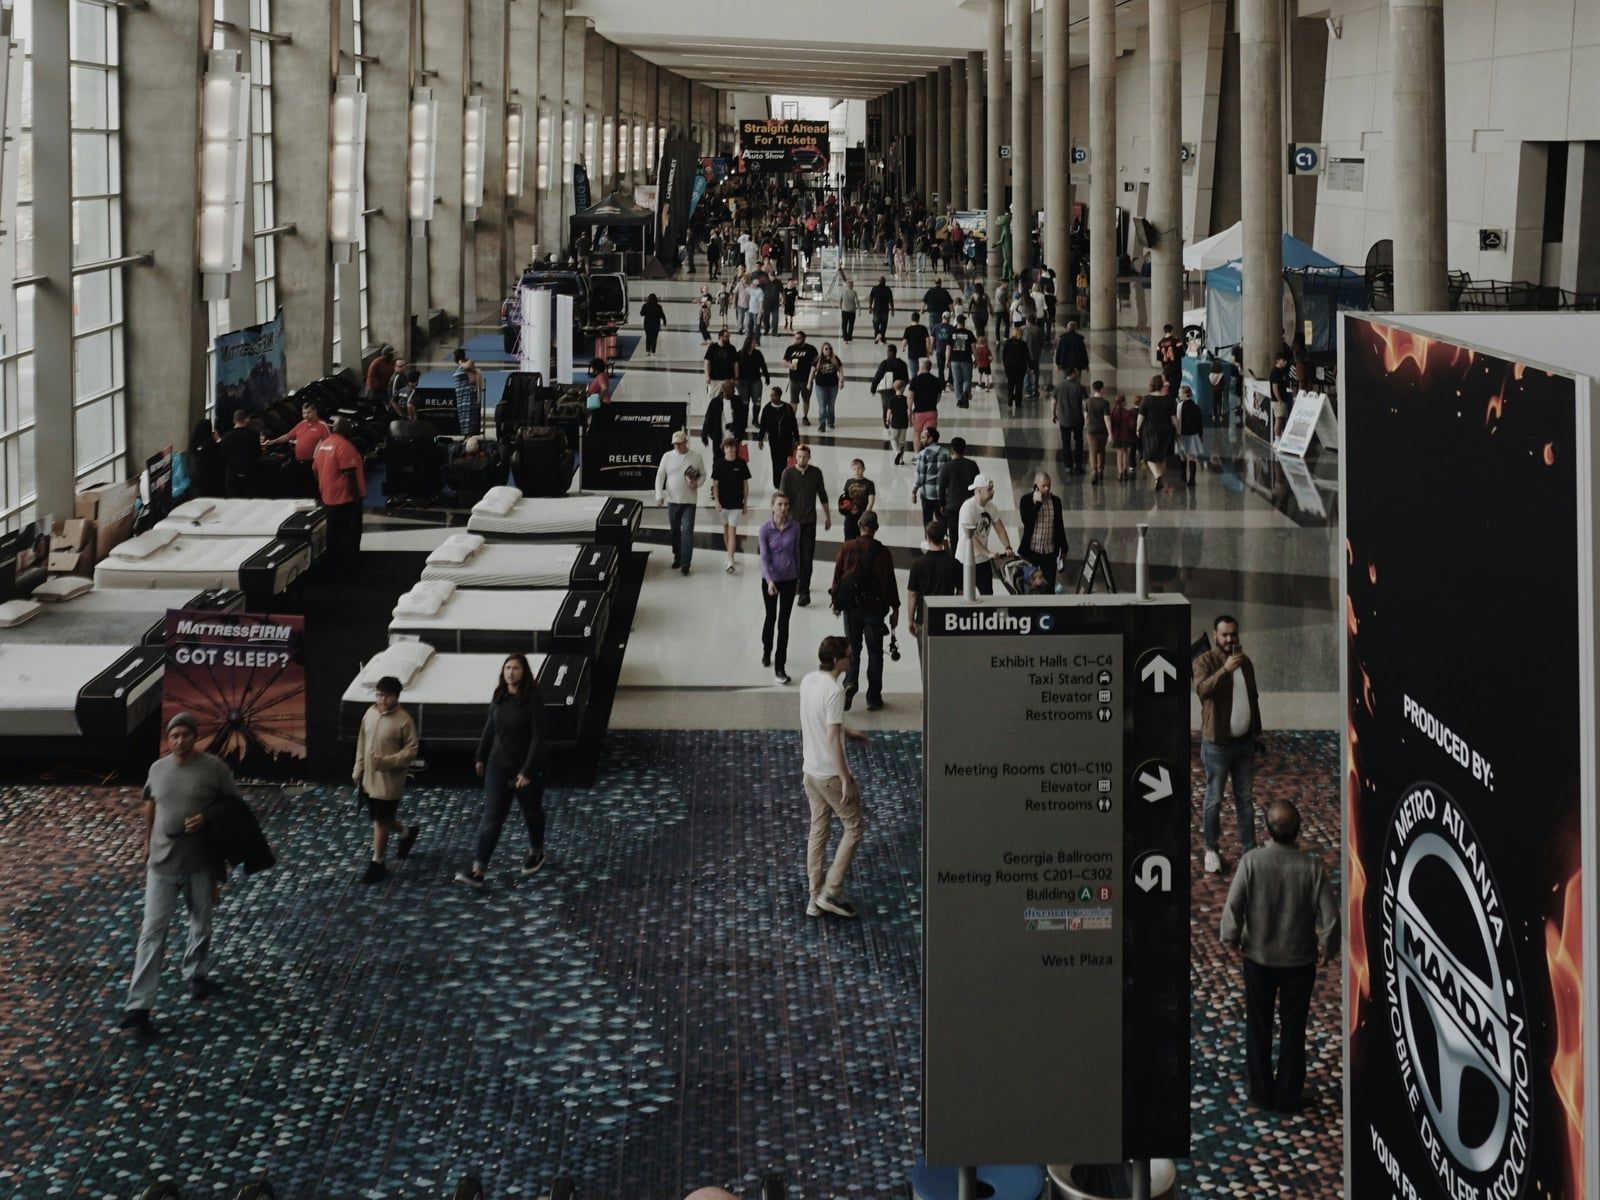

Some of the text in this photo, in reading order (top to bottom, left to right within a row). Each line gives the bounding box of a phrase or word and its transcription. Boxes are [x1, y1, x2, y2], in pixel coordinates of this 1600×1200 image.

[744, 123, 827, 135] Straight Ahead
[754, 135, 817, 145] For Tickets
[742, 149, 764, 160] Auto
[765, 152, 785, 160] Show
[1295, 153, 1312, 166] C1
[424, 398, 455, 407] RELAX
[608, 454, 652, 463] RELIEVE
[945, 612, 1050, 635] Building C
[175, 648, 289, 668] GOT SLEEP?
[990, 655, 1034, 668] Exhibit
[1039, 655, 1068, 667] Halls
[1029, 672, 1093, 685] Taxi Stand
[1041, 691, 1092, 703] Elevator
[1025, 709, 1093, 721] Restrooms
[1403, 693, 1494, 792] PRODUCED BY:
[944, 763, 998, 779] Meeting
[1002, 763, 1045, 776] Rooms
[1041, 780, 1092, 793] Elevator
[1025, 799, 1093, 811] Restrooms
[1003, 850, 1113, 867] Georgia Ballroom
[1394, 789, 1504, 949] METRO ATLANTA
[937, 871, 991, 886] Meeting
[995, 870, 1038, 883] Rooms
[1026, 888, 1109, 903] Building A B
[1041, 953, 1113, 967] West Plaza
[1382, 867, 1420, 1113] AUTOMOBILE
[1403, 919, 1503, 1072] MAADA
[1370, 1123, 1423, 1200] YOUR FR
